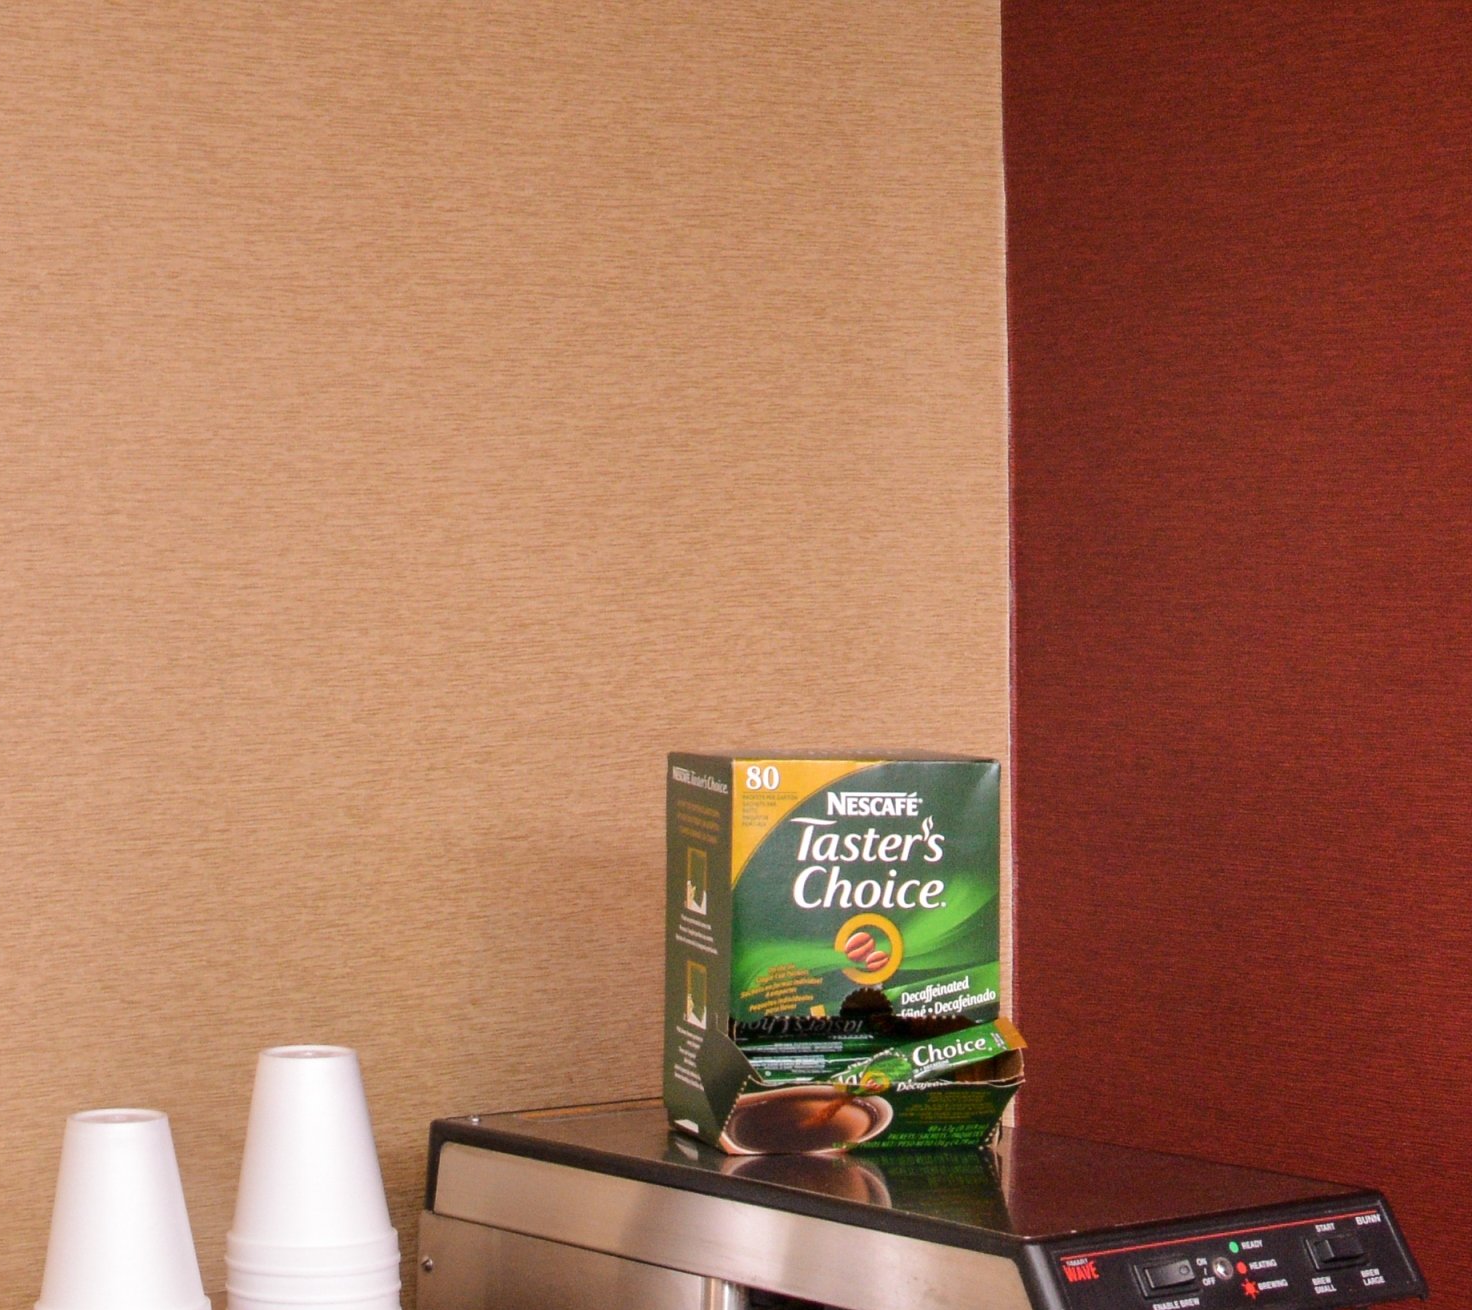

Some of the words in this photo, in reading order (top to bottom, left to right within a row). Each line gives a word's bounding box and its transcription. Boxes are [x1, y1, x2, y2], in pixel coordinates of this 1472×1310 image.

[746, 766, 780, 790] 80
[827, 790, 919, 816] NESCAFÉ
[791, 815, 945, 863] Taster's
[793, 865, 946, 909] Choice.
[901, 976, 969, 1005] Decaffeinated
[935, 988, 996, 1015] Decafeinado
[913, 1038, 992, 1067] Choice.
[1355, 1214, 1381, 1225] BUNN
[1315, 1223, 1335, 1232] START
[1241, 1240, 1263, 1249] READY
[1248, 1259, 1277, 1270] HEATING
[1063, 1261, 1100, 1283] WAVE
[1360, 1268, 1380, 1278] BREW
[1202, 1277, 1216, 1286] OFF
[1258, 1279, 1288, 1291] BREWING
[1312, 1276, 1332, 1285] BREW
[1180, 1298, 1200, 1308] BREW
